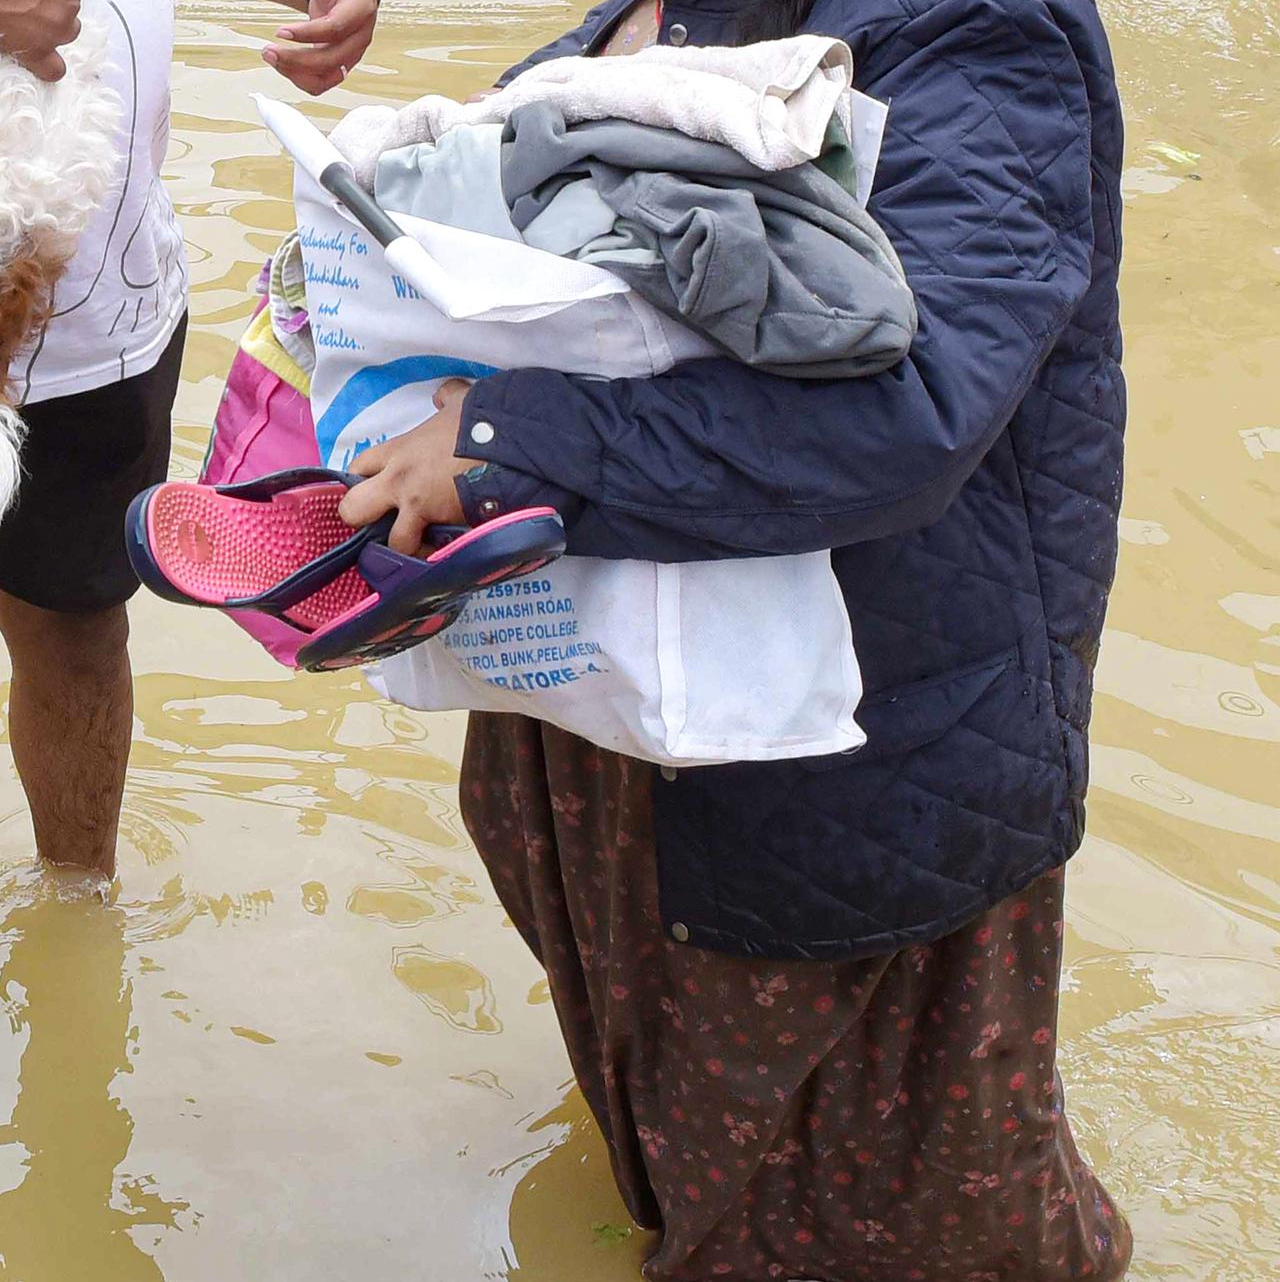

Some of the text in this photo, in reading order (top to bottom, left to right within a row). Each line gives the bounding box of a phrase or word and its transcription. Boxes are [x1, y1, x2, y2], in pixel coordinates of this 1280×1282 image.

[349, 231, 368, 255] For
[486, 580, 551, 599] 2597550
[536, 598, 575, 615] ROAD,
[440, 620, 579, 650] ARGUS HOPE COLLEGE
[463, 655, 499, 670] TROL
